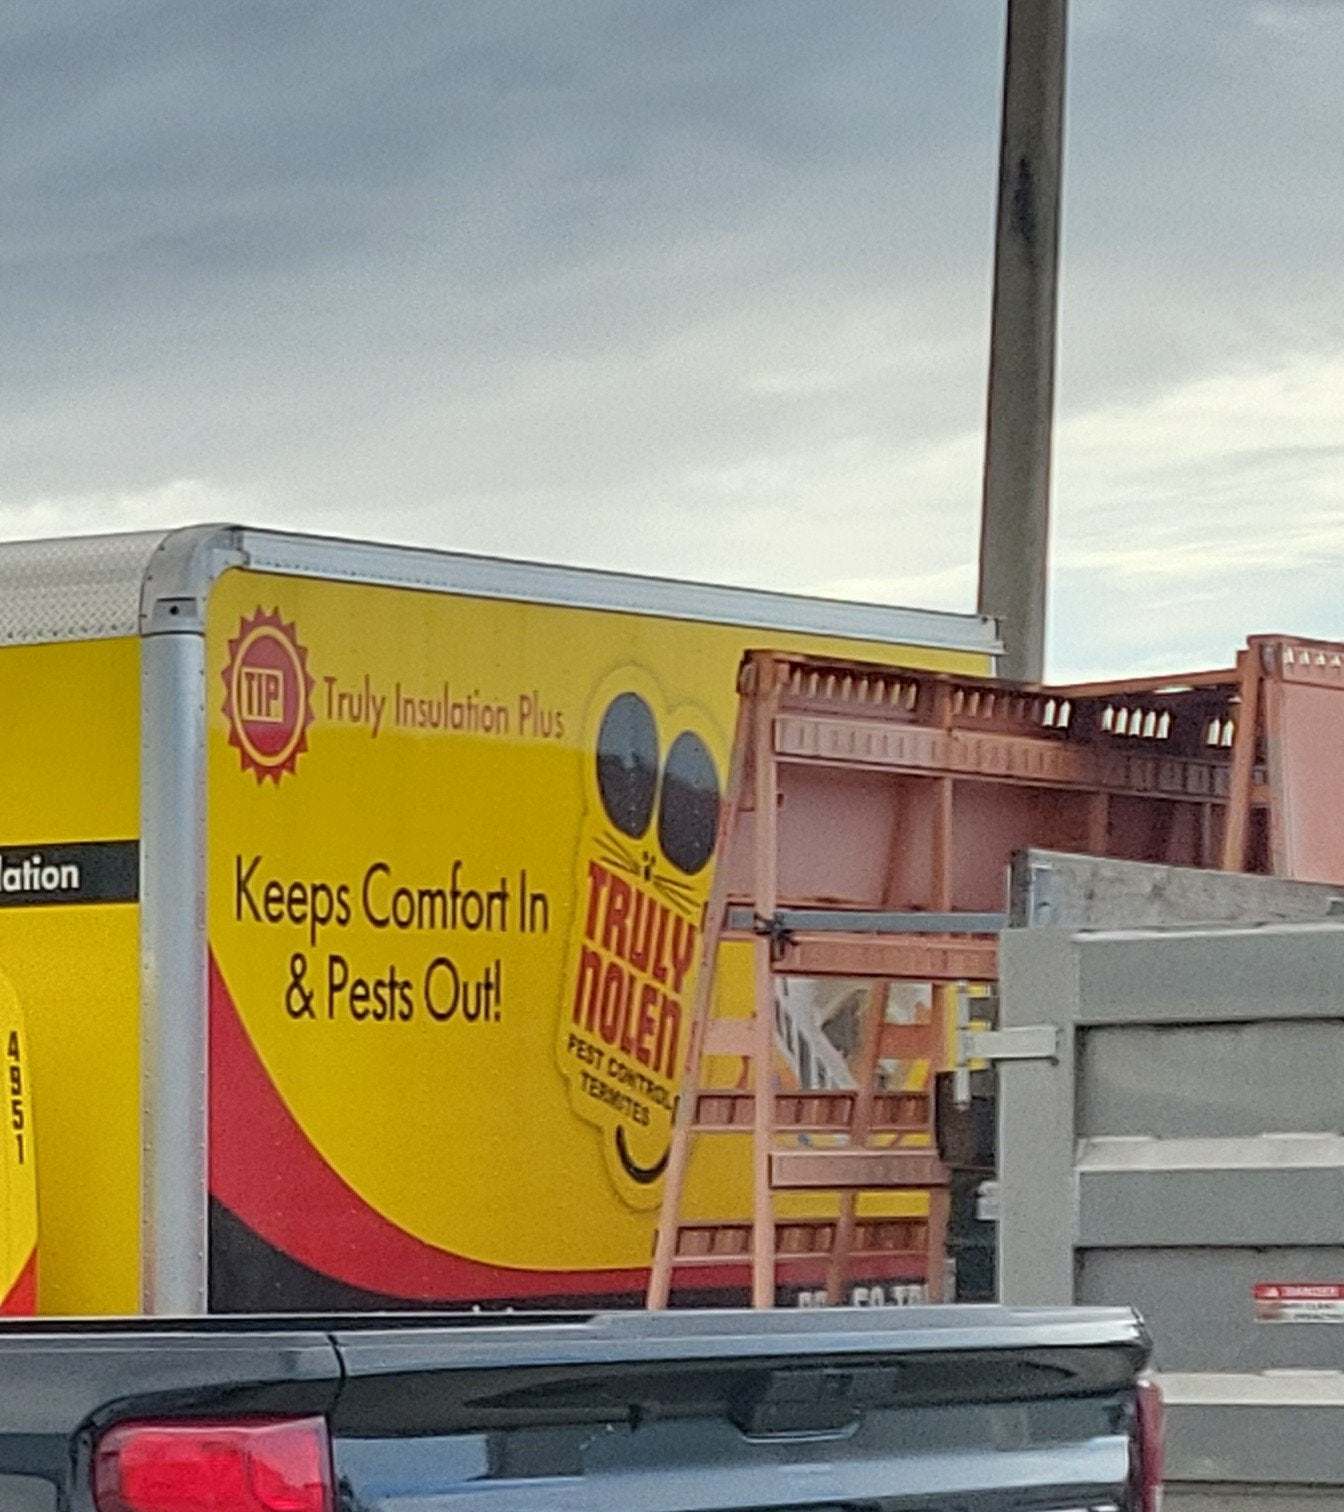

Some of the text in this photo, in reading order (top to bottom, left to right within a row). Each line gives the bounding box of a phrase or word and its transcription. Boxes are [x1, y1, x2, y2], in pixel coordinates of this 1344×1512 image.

[241, 671, 281, 720] TIP
[324, 676, 564, 739] Truly Insulation Plus
[235, 855, 550, 946] Keeps Comfort In
[588, 859, 697, 996] TRULY
[284, 953, 503, 1023] & Pests Out!
[573, 945, 683, 1081] NOLEN
[567, 1033, 605, 1071] PEST
[580, 1069, 651, 1128] TERMITES
